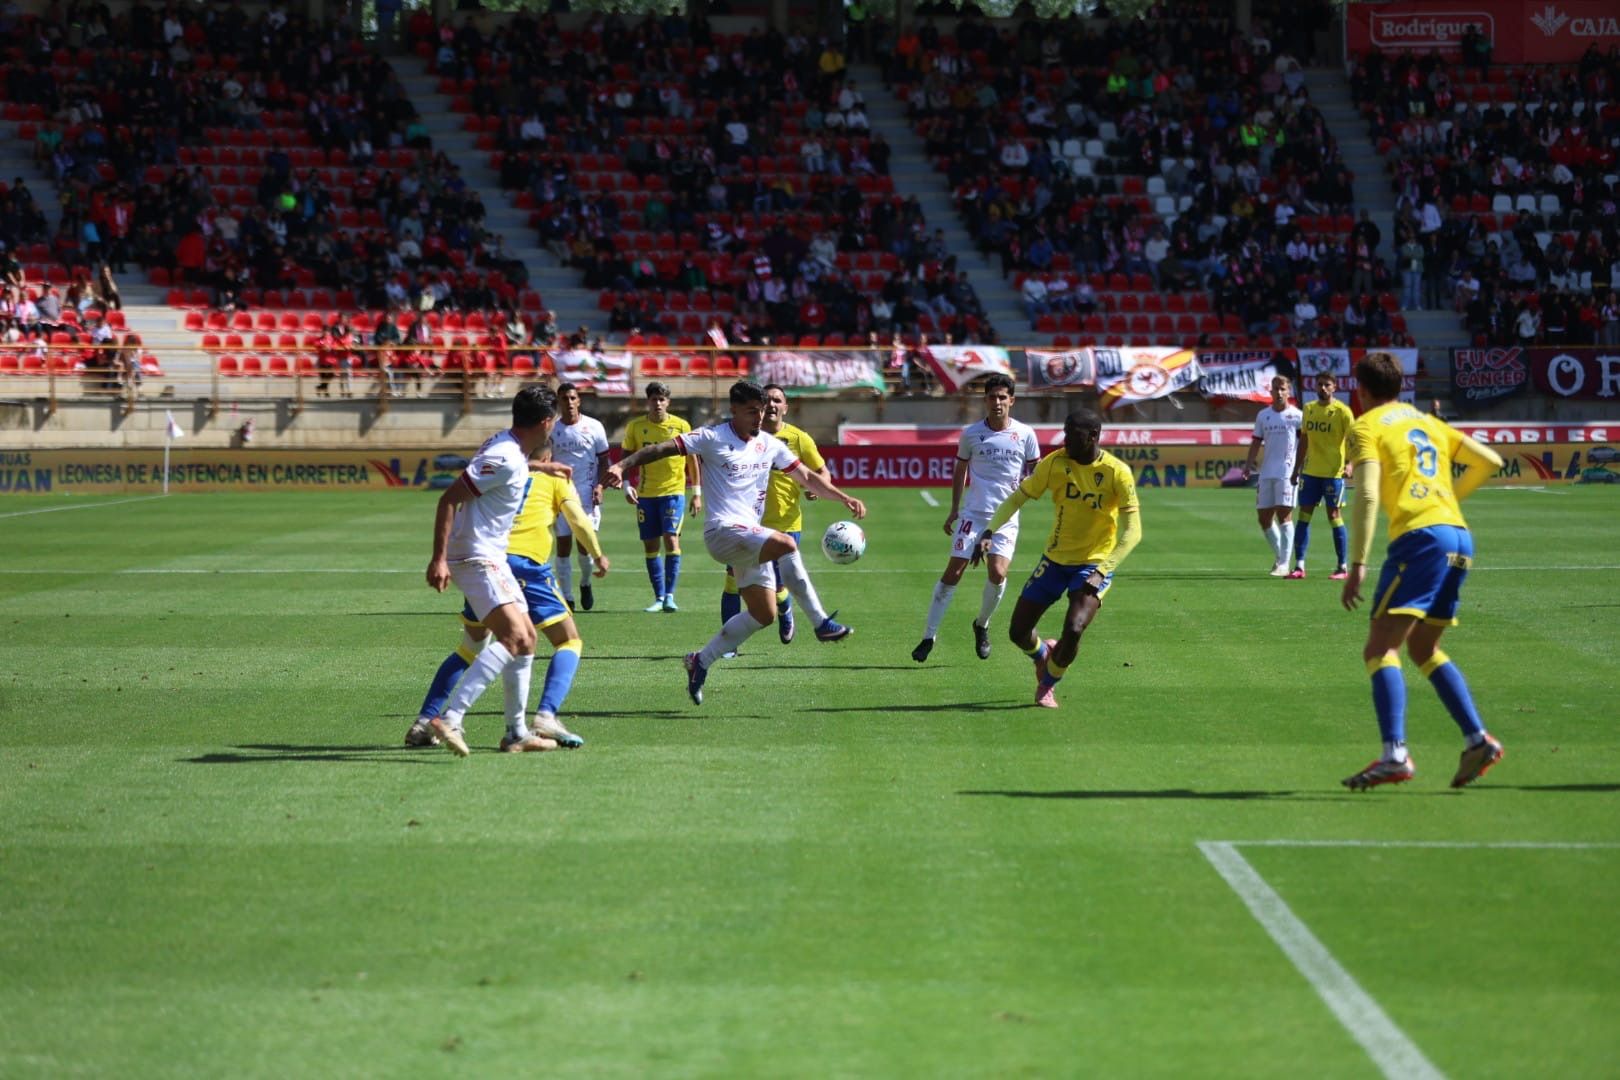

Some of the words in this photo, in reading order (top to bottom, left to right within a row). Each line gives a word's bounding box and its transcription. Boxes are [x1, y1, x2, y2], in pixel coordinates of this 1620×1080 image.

[1456, 371, 1526, 388] CANCER
[1306, 421, 1332, 433] DIGI
[1407, 428, 1438, 477] 8
[58, 464, 122, 484] LEONESA
[127, 464, 147, 484] DE
[151, 464, 242, 484] AISTENCIA
[247, 464, 267, 483] EN
[273, 464, 369, 483] CARRETERA
[721, 462, 769, 471] ASPIRE
[843, 458, 869, 479] DE
[873, 458, 923, 479] ALTO
